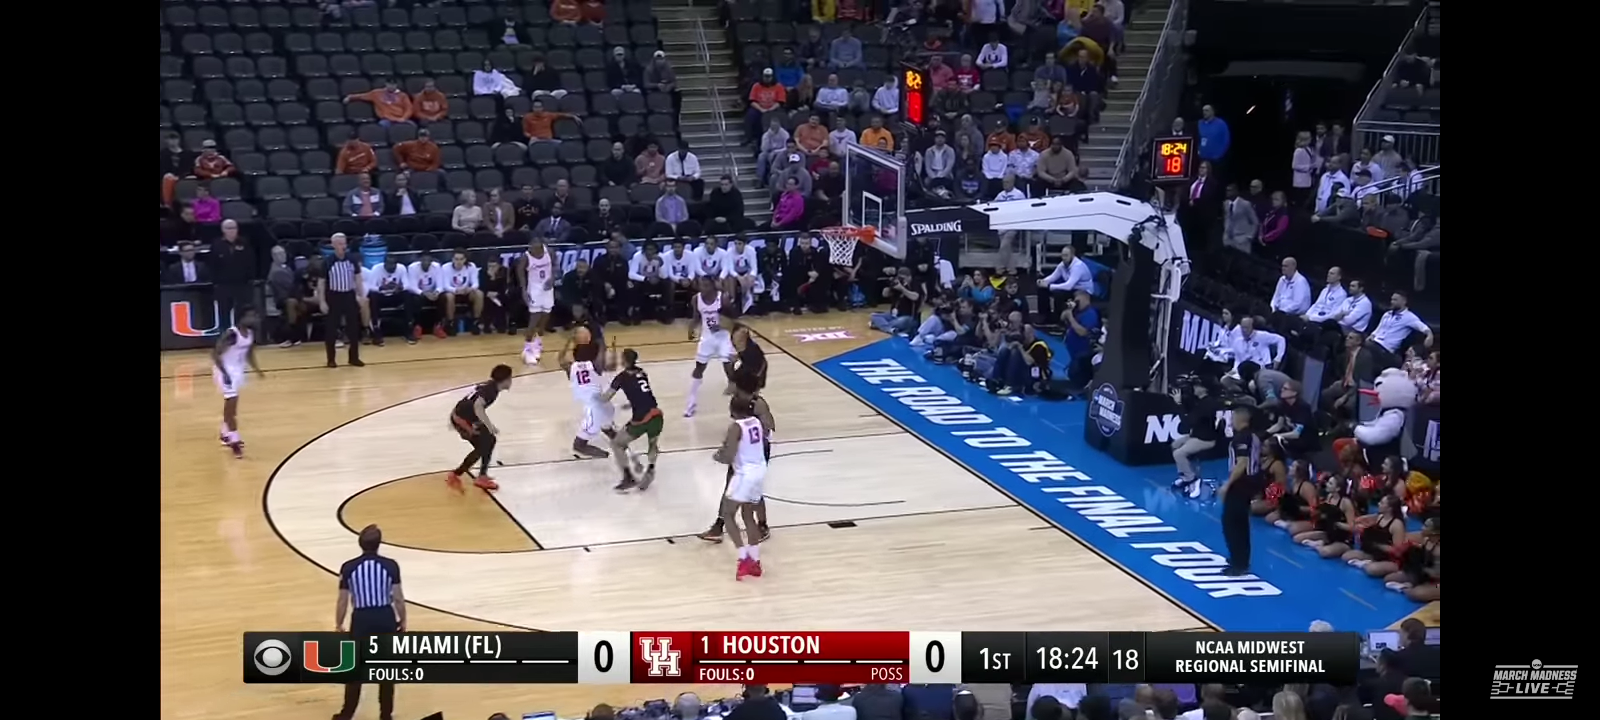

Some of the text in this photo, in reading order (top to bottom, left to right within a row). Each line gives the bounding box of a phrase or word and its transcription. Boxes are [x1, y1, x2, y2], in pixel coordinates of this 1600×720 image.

[1161, 142, 1187, 156] 18:24
[1167, 156, 1181, 173] 18
[911, 220, 963, 236] SPALDING
[170, 300, 234, 337] U
[1180, 309, 1221, 354] MA
[576, 370, 590, 385] 12
[748, 426, 760, 444] 13
[840, 358, 1283, 598] THE ROAD TO THE FINAL FOUR
